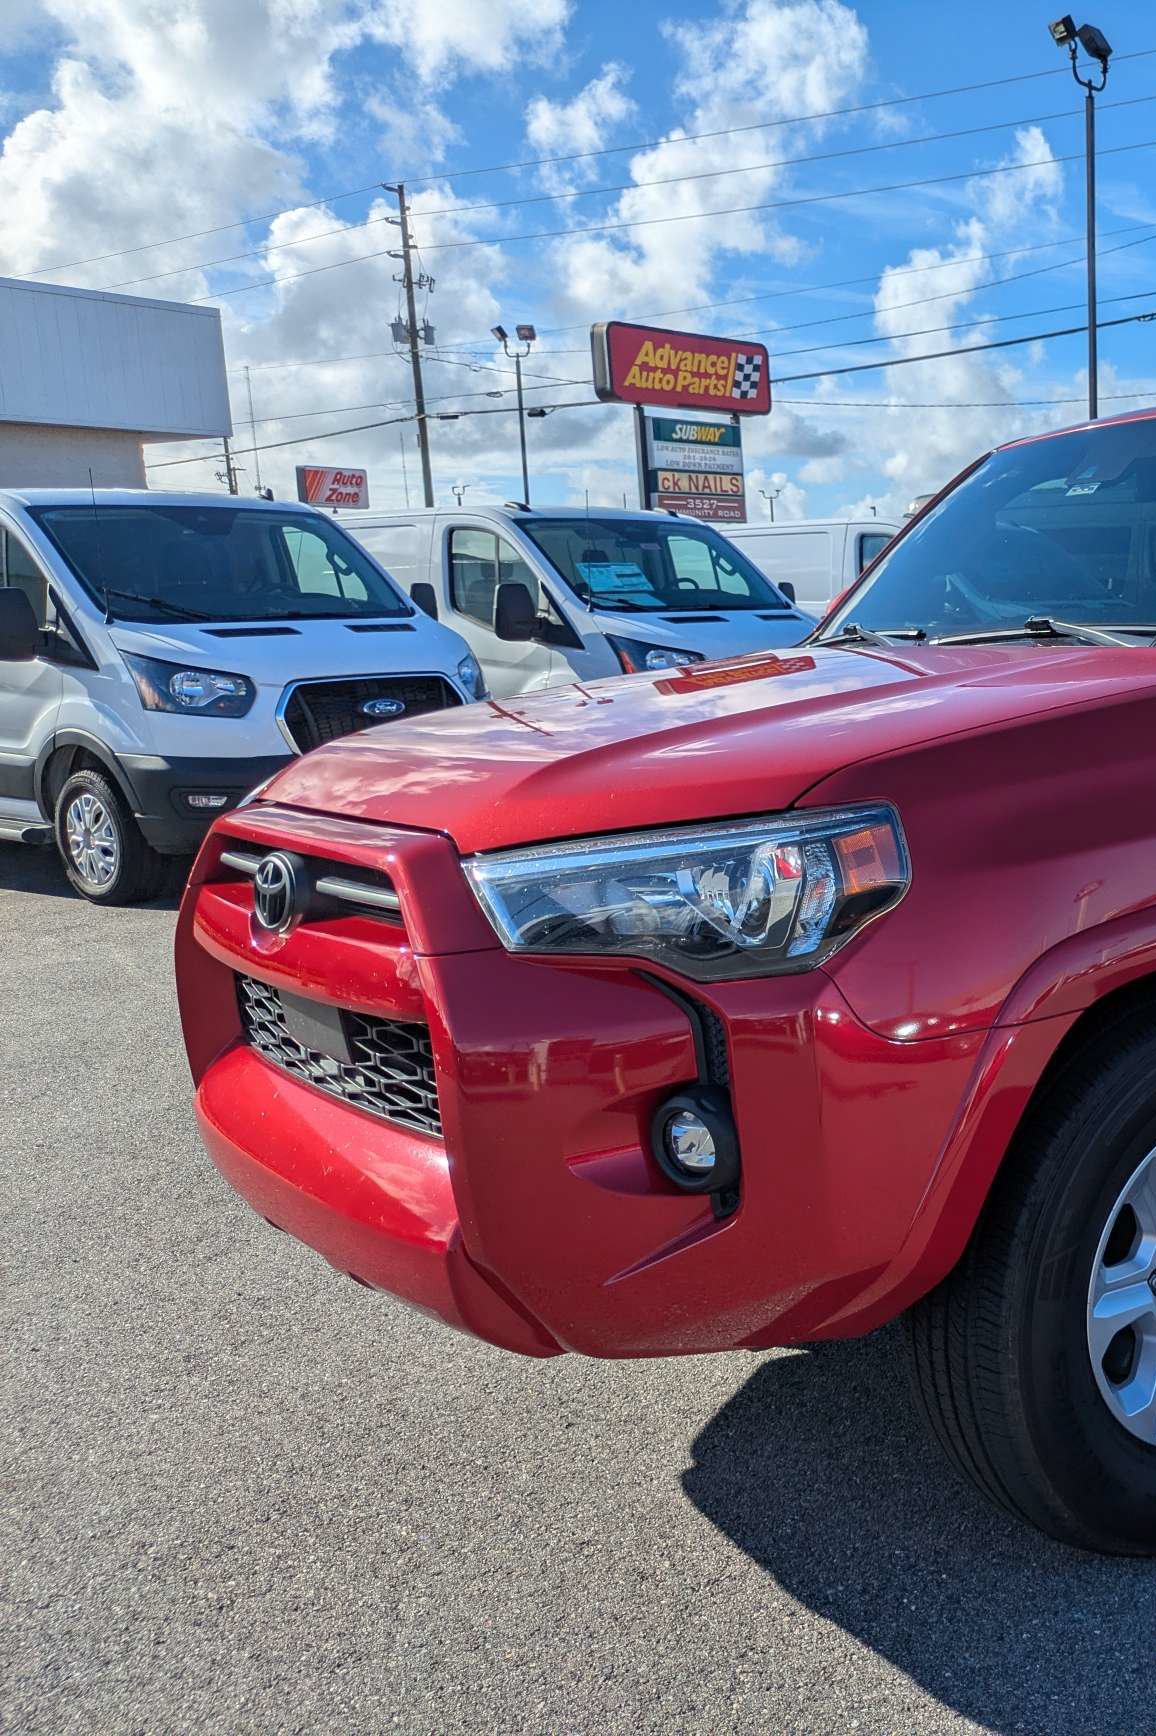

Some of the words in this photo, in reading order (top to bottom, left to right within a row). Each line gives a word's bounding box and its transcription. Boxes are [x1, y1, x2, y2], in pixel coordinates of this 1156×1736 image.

[635, 340, 729, 376] Advance
[624, 365, 675, 392] Auto
[675, 371, 726, 397] Parts
[672, 424, 725, 443] SUBWAY
[332, 471, 363, 486] Auto
[688, 474, 740, 494] NAILS
[324, 488, 360, 503] Zone
[686, 499, 718, 509] 3527
[670, 508, 714, 518] MMUNITY
[718, 510, 741, 518] ROAD
